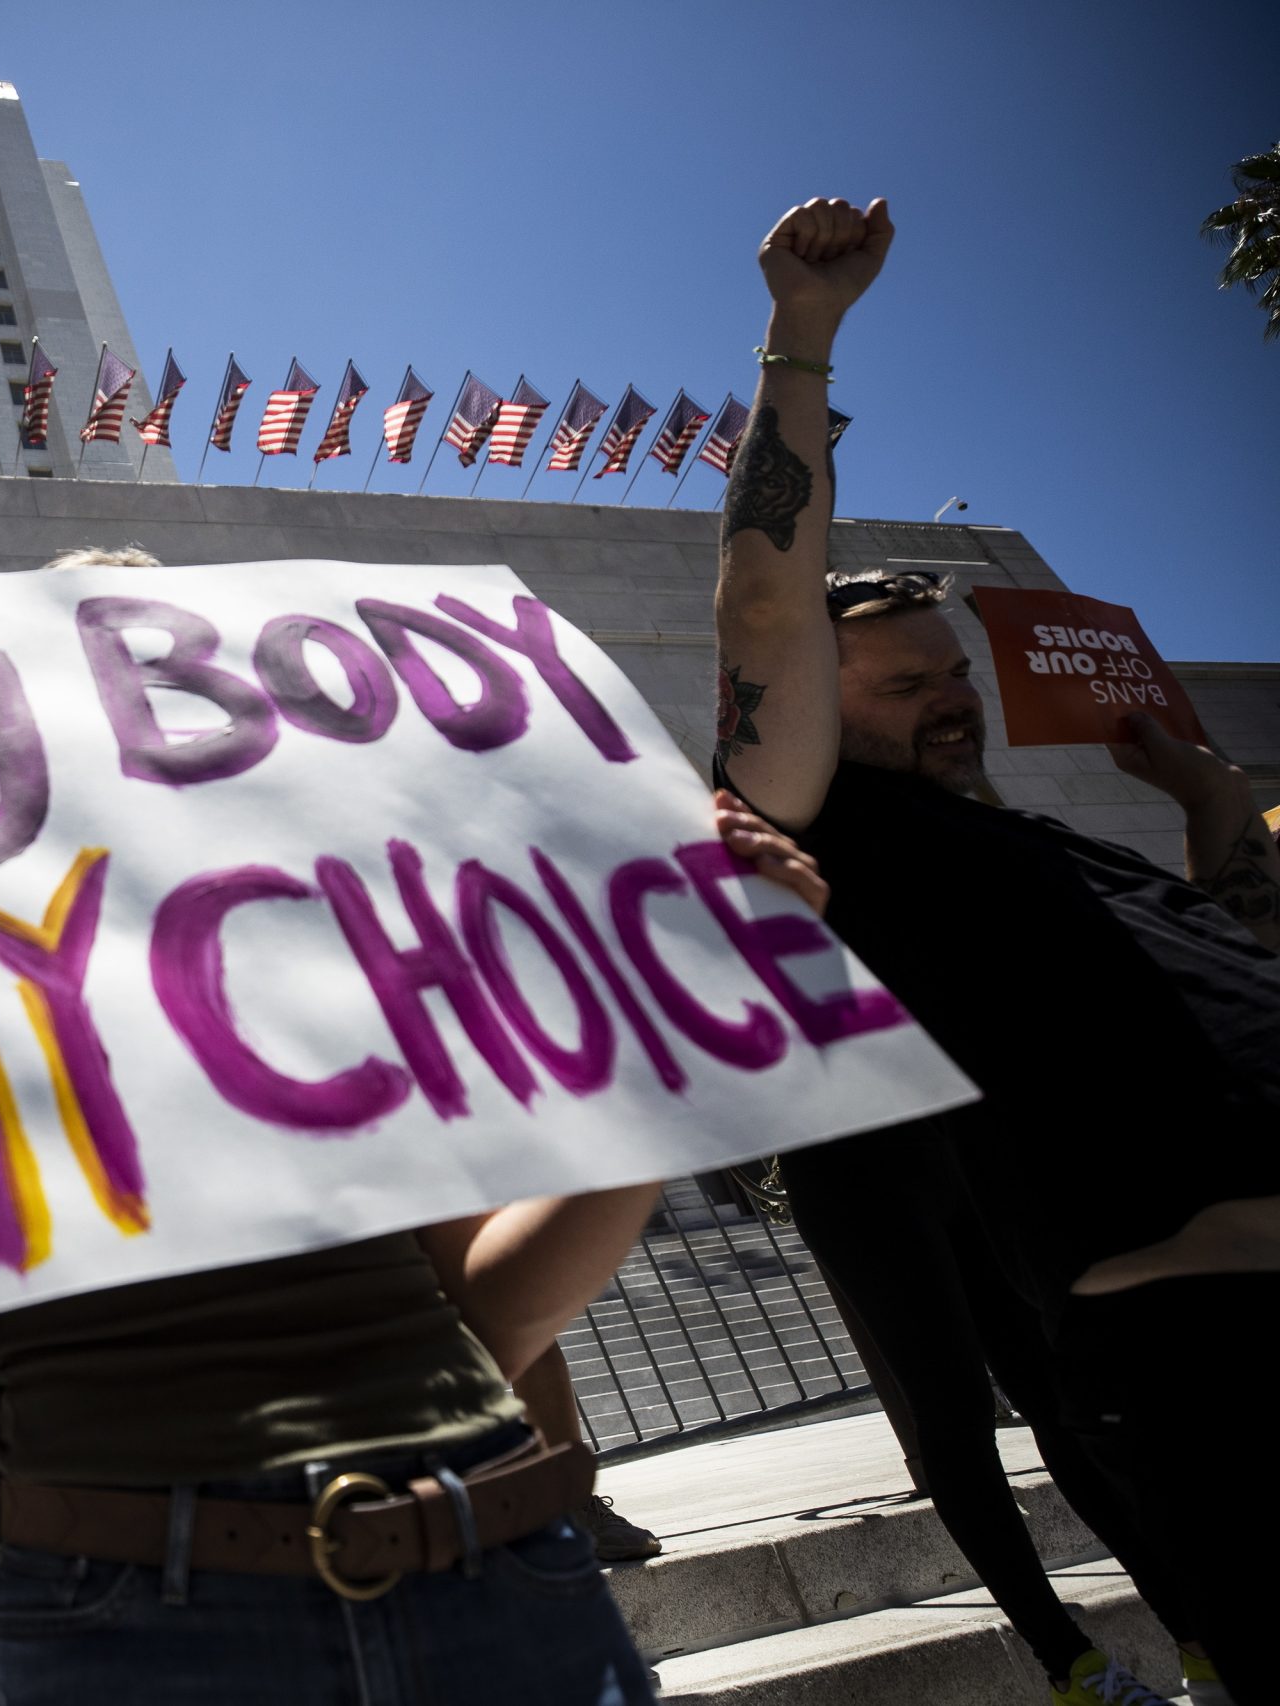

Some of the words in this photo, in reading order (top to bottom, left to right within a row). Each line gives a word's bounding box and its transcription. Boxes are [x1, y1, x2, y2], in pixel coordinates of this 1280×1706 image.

[1033, 624, 1140, 655] BODIES
[1024, 650, 1097, 675] OUR
[1102, 655, 1153, 680] OFF
[75, 592, 641, 787] BODY
[1090, 680, 1168, 706] BANS
[147, 837, 913, 1134] CHOICE
